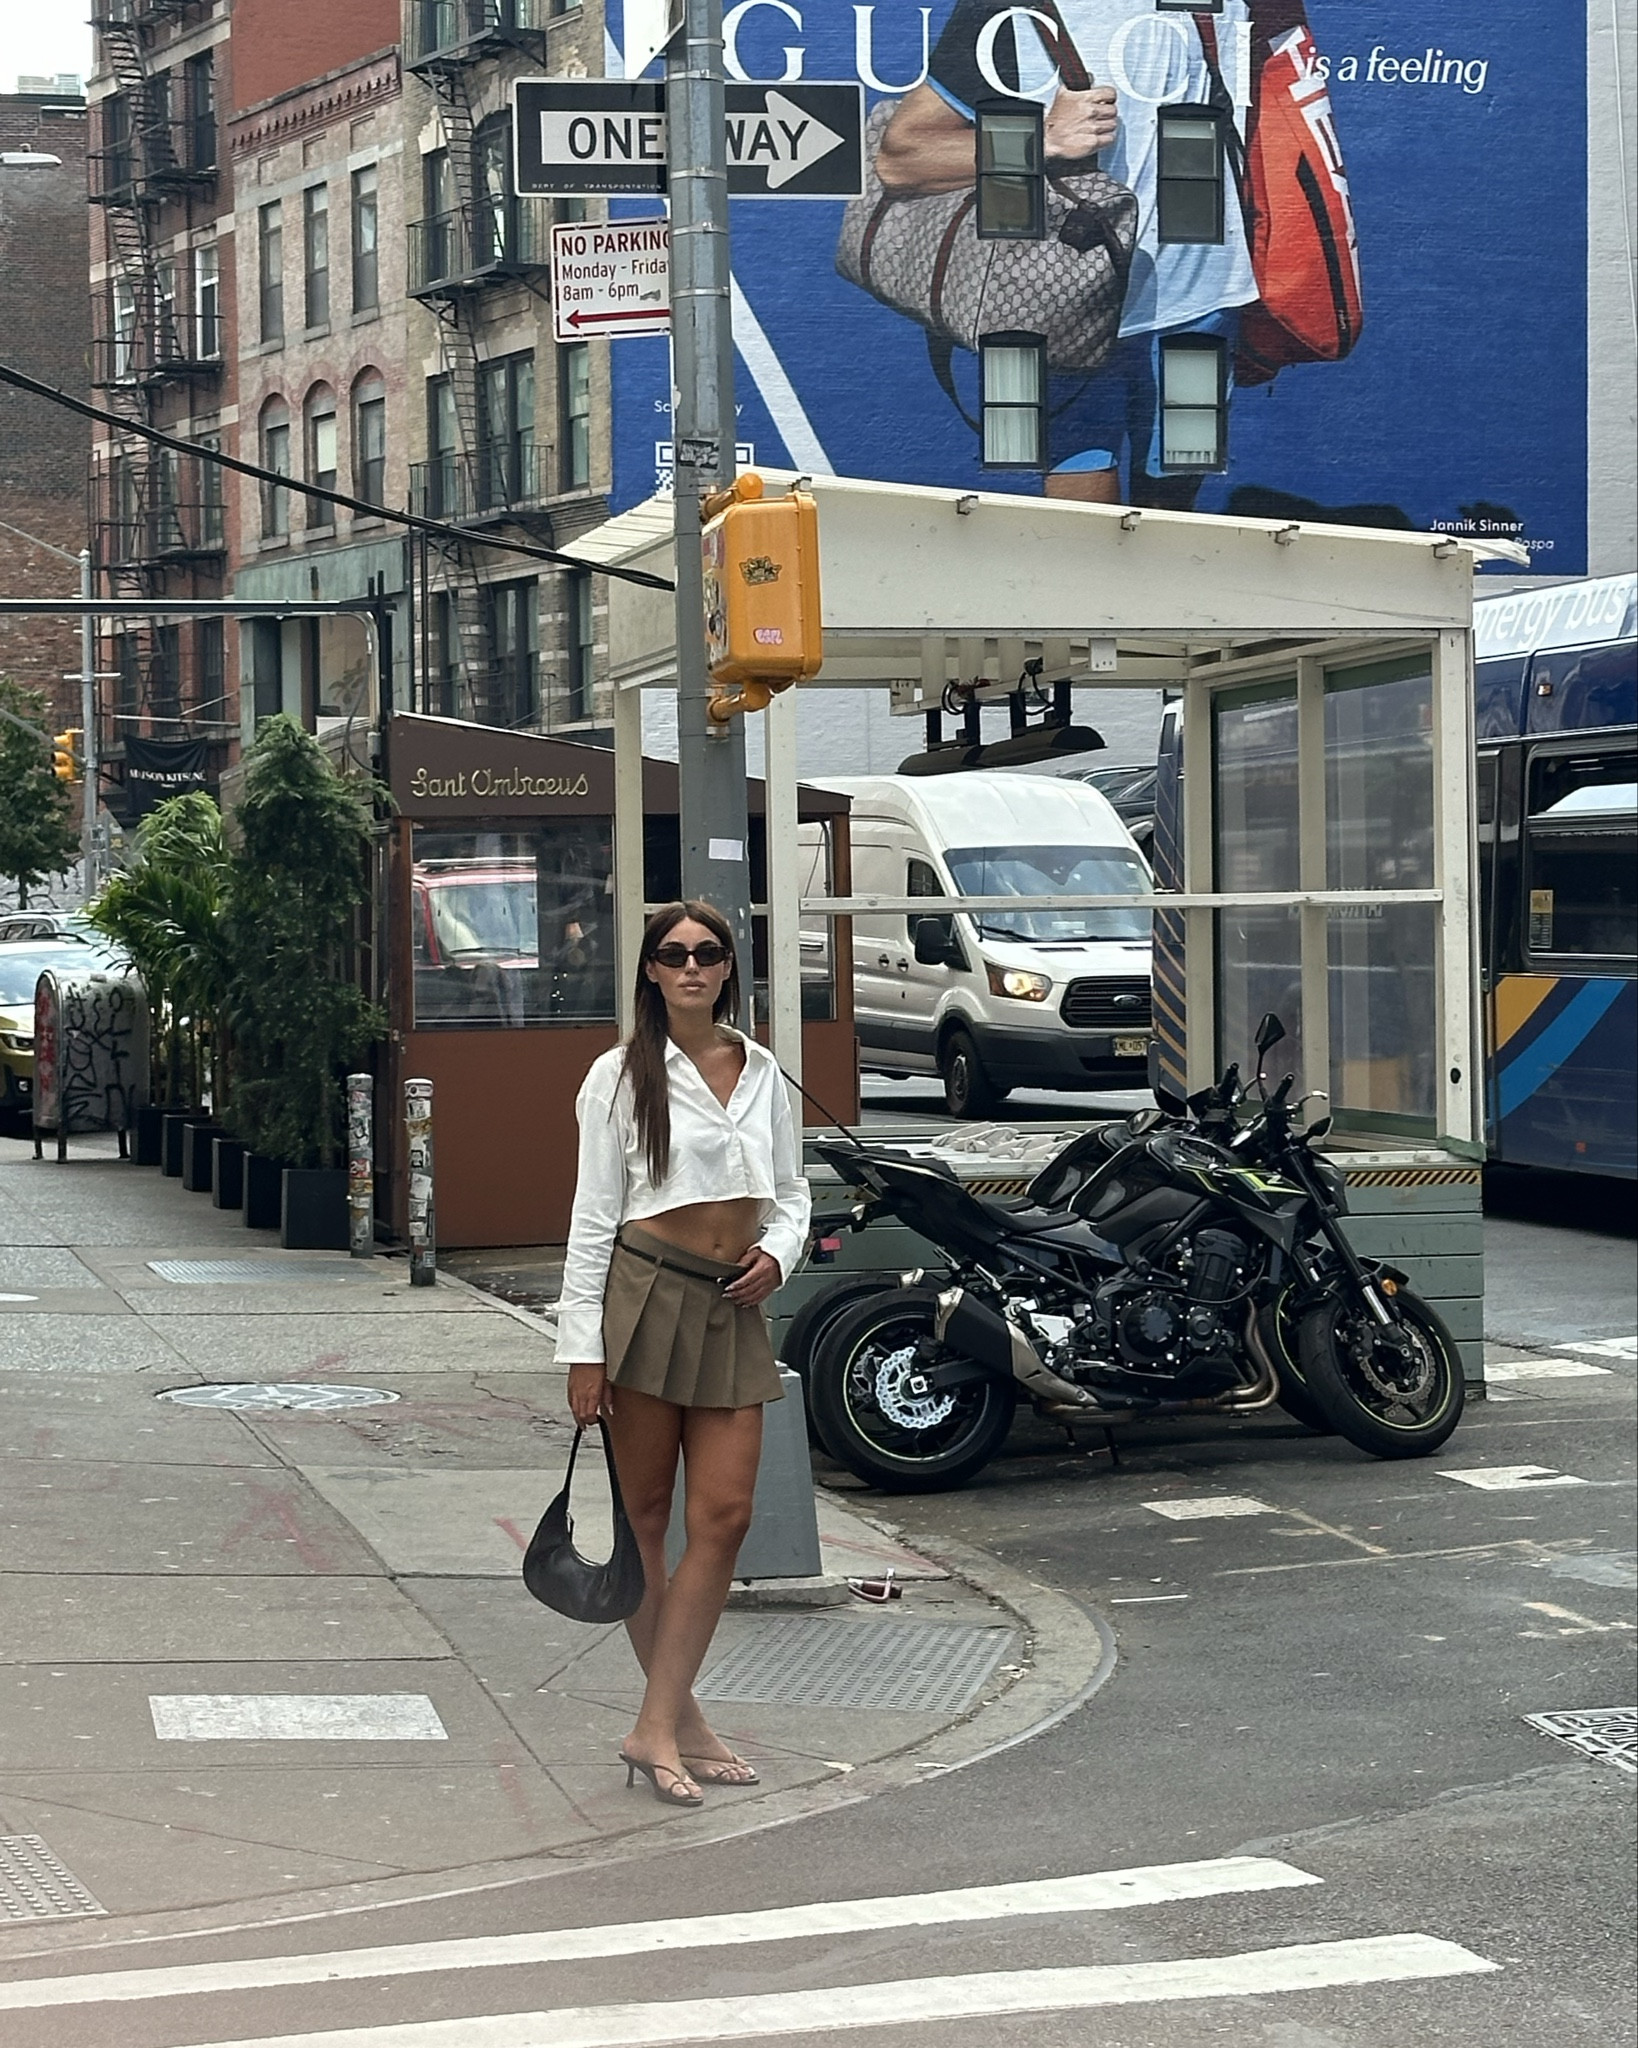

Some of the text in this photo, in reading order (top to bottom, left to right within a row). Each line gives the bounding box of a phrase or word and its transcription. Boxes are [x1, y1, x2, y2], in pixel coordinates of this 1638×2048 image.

[722, 0, 1488, 108] GUCCI is a feeling
[568, 117, 664, 160] ONE
[561, 235, 587, 257] NO
[562, 262, 616, 280] Monday
[631, 258, 668, 275] Frida
[563, 285, 593, 301] 8am
[608, 281, 638, 301] 6pm
[1430, 519, 1524, 532] Jannik Sinner
[1565, 580, 1631, 630] bus
[410, 768, 467, 797] Sant
